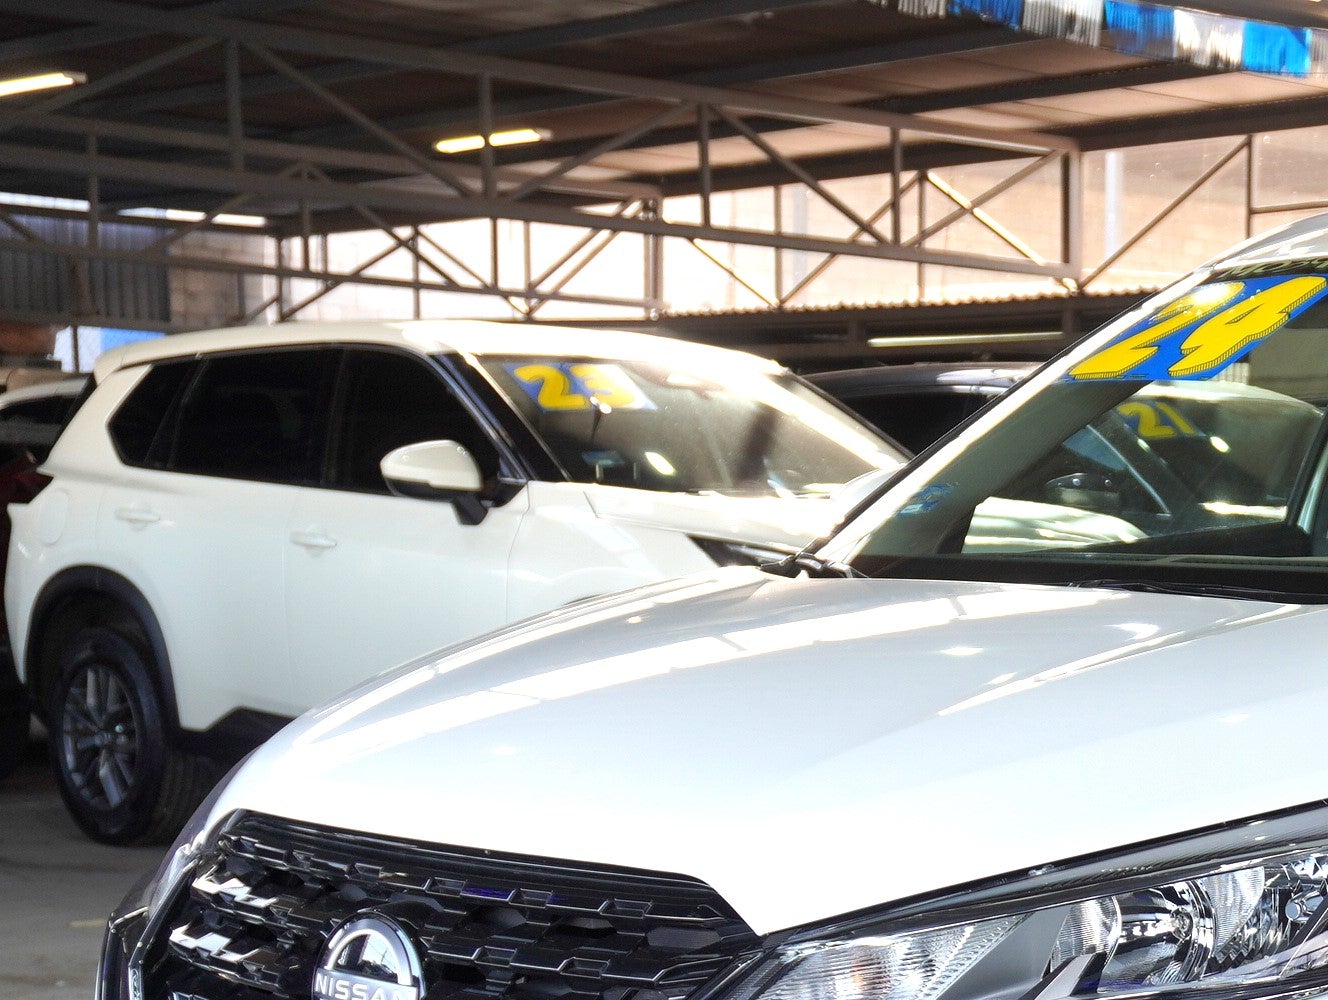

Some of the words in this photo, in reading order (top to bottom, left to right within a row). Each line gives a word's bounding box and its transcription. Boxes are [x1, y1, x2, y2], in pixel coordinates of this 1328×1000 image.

[1067, 276, 1328, 381] 24
[513, 363, 636, 411] 23
[1116, 400, 1199, 440] 21
